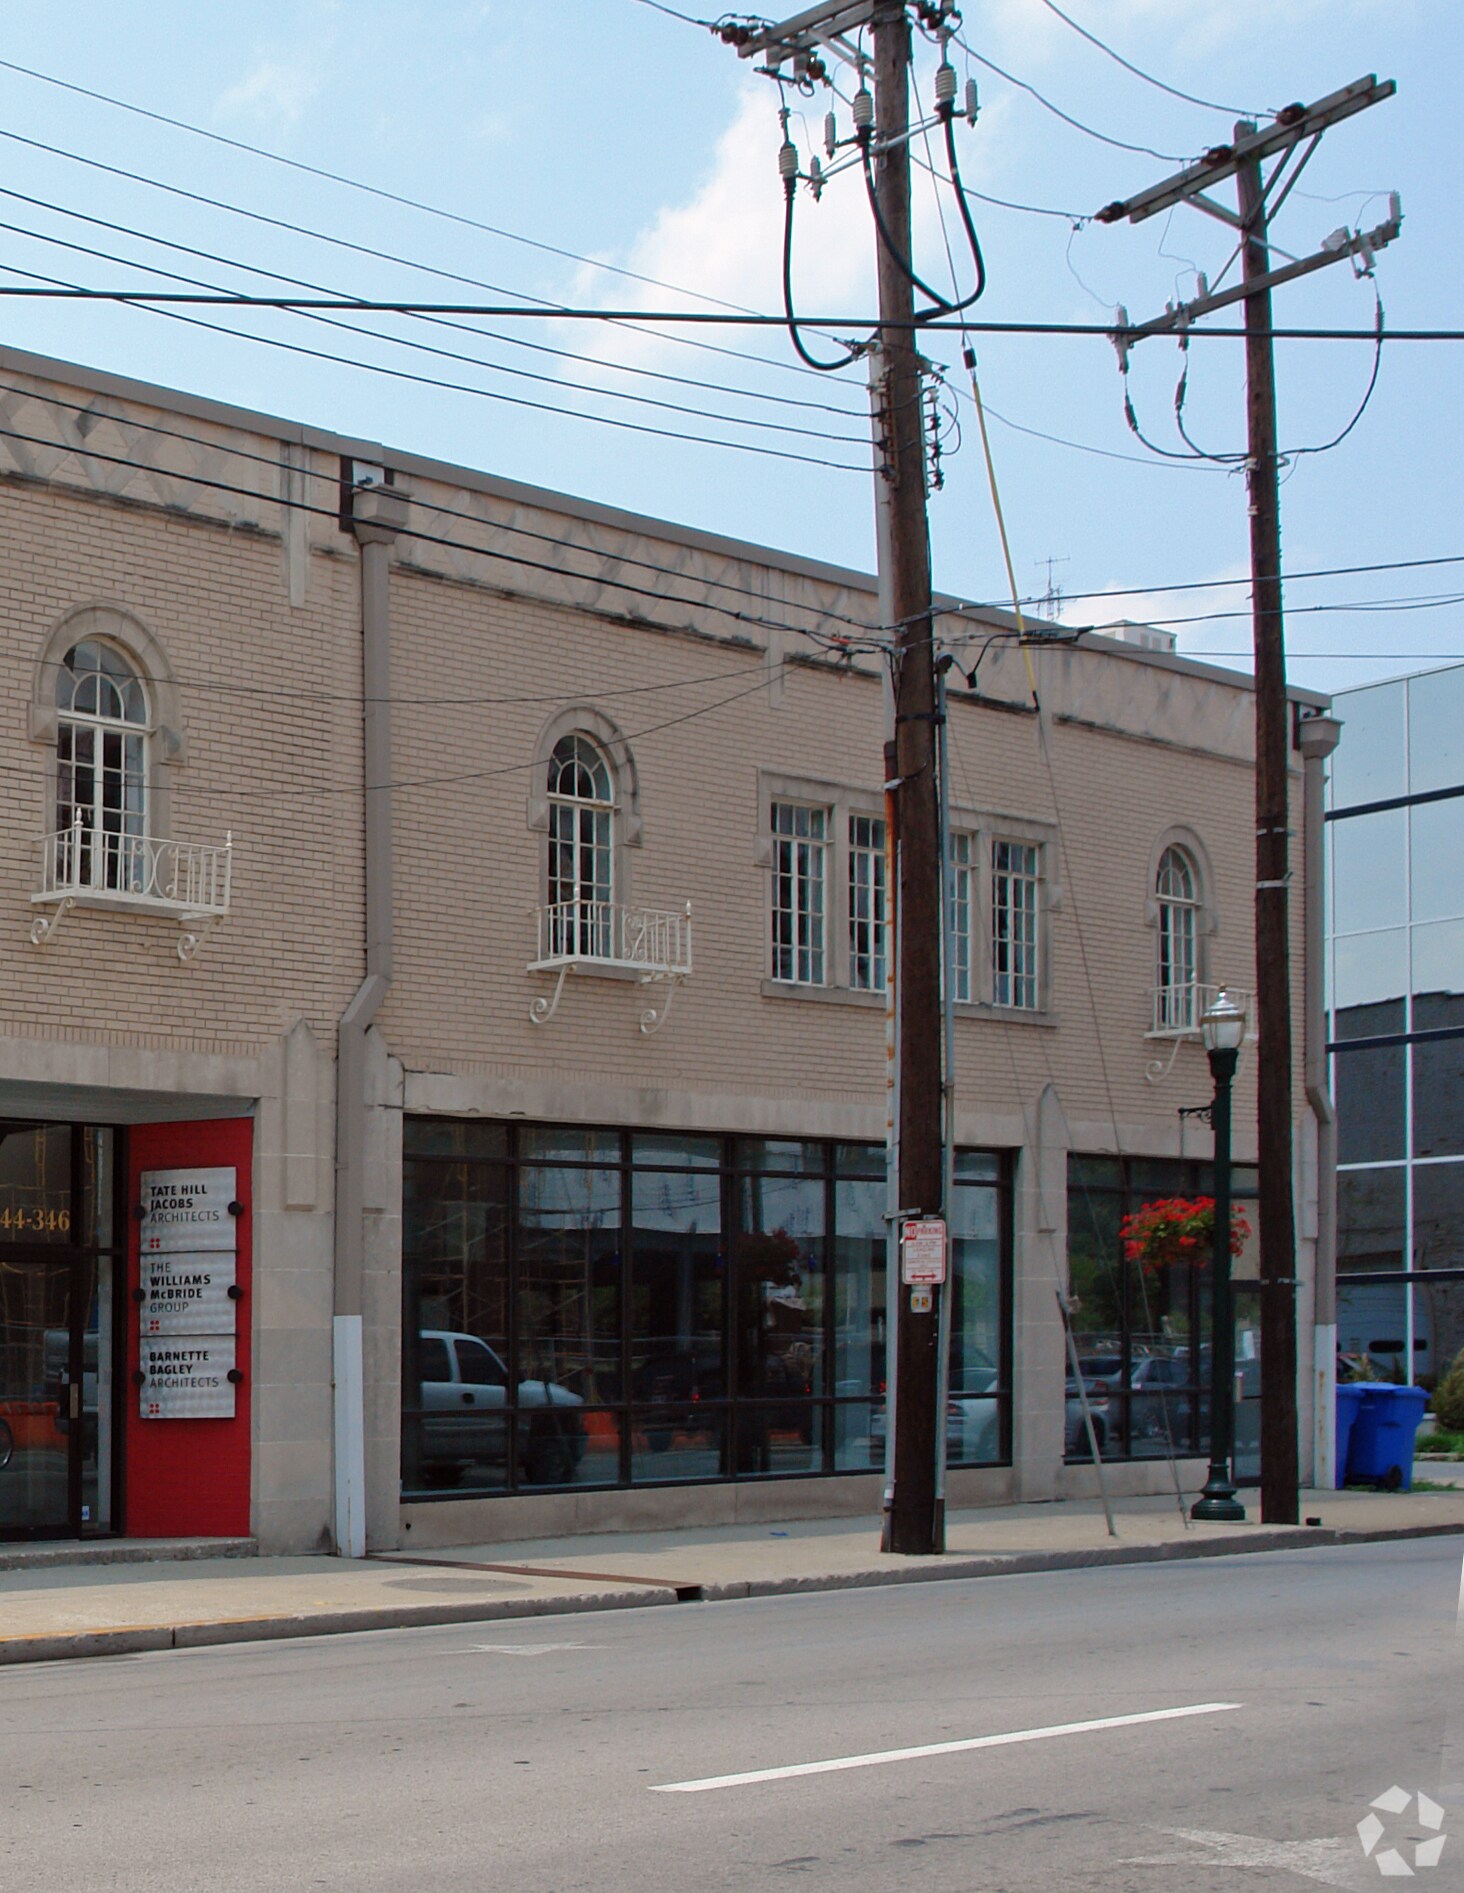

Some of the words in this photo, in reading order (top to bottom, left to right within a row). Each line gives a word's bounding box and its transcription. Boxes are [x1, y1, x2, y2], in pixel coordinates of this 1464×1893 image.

[150, 1185, 177, 1197] TATE
[181, 1184, 208, 1195] HILL
[150, 1198, 194, 1212] JACOBS
[150, 1210, 220, 1223] ARCHITECTS
[150, 1262, 171, 1273] THE
[150, 1274, 211, 1287] WILLIAMS
[150, 1288, 203, 1300] McBRIDE
[150, 1302, 189, 1313] GROUP
[149, 1350, 209, 1362] BARNETTE
[149, 1364, 193, 1375] BAGLEY
[149, 1376, 220, 1388] ARCHITECTS
